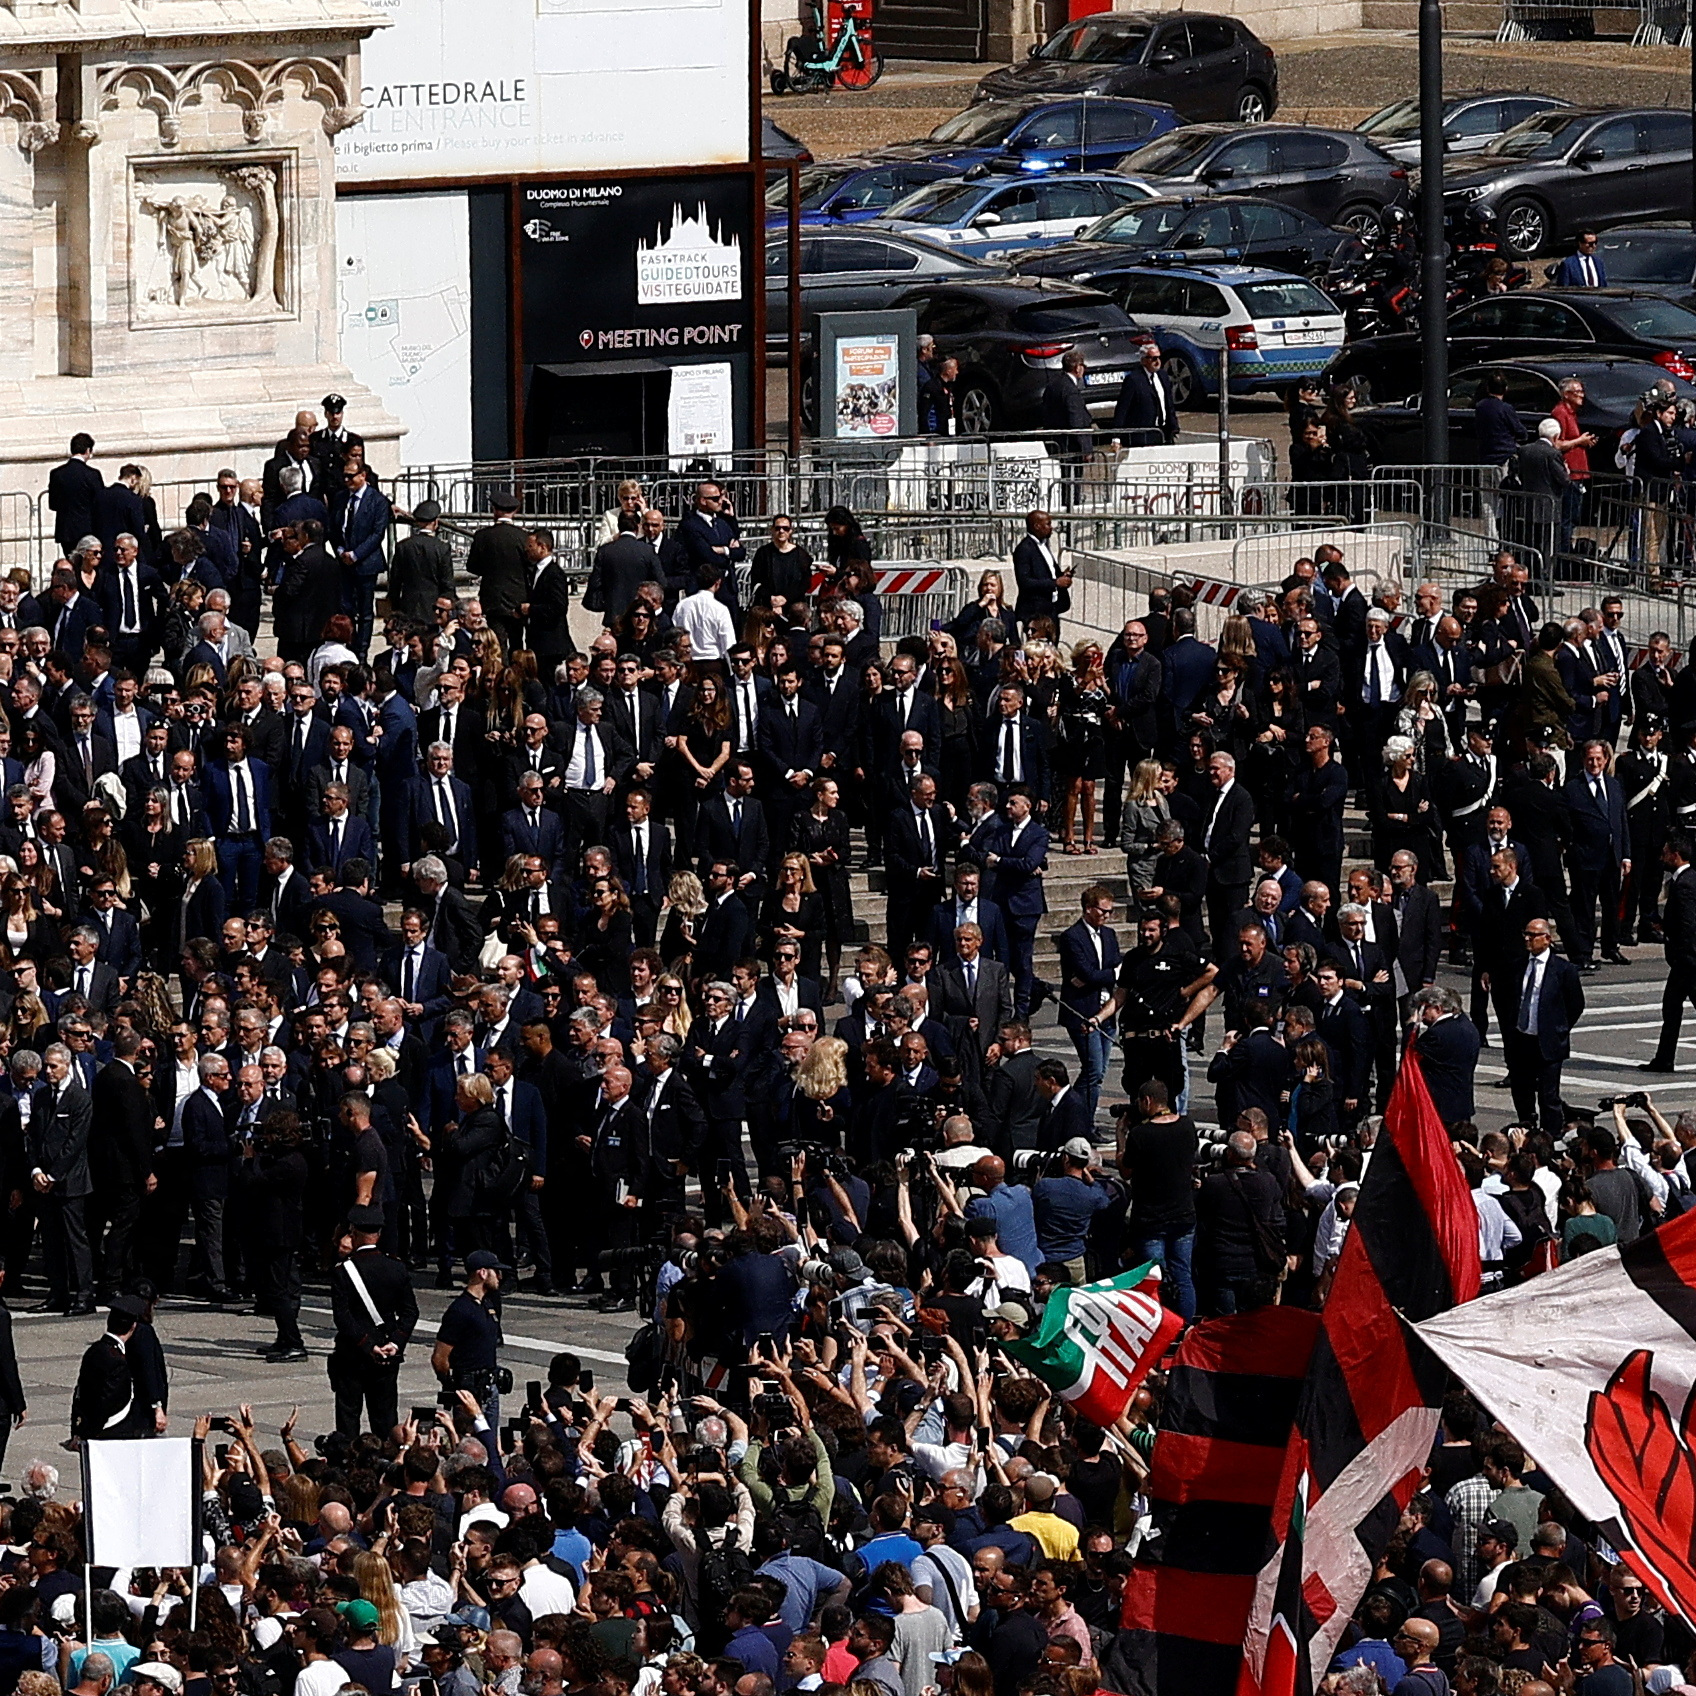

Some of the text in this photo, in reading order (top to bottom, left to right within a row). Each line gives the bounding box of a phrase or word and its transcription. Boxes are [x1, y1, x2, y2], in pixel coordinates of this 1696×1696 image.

[360, 79, 526, 109] CATTEDRALE
[392, 104, 532, 133] ENTRANCE
[354, 140, 399, 157] biglietto
[402, 140, 433, 156] prima
[482, 136, 501, 150] buy
[505, 136, 530, 150] your
[527, 186, 622, 200] DUOMO DI MILANO
[598, 324, 742, 349] MEETING POINT
